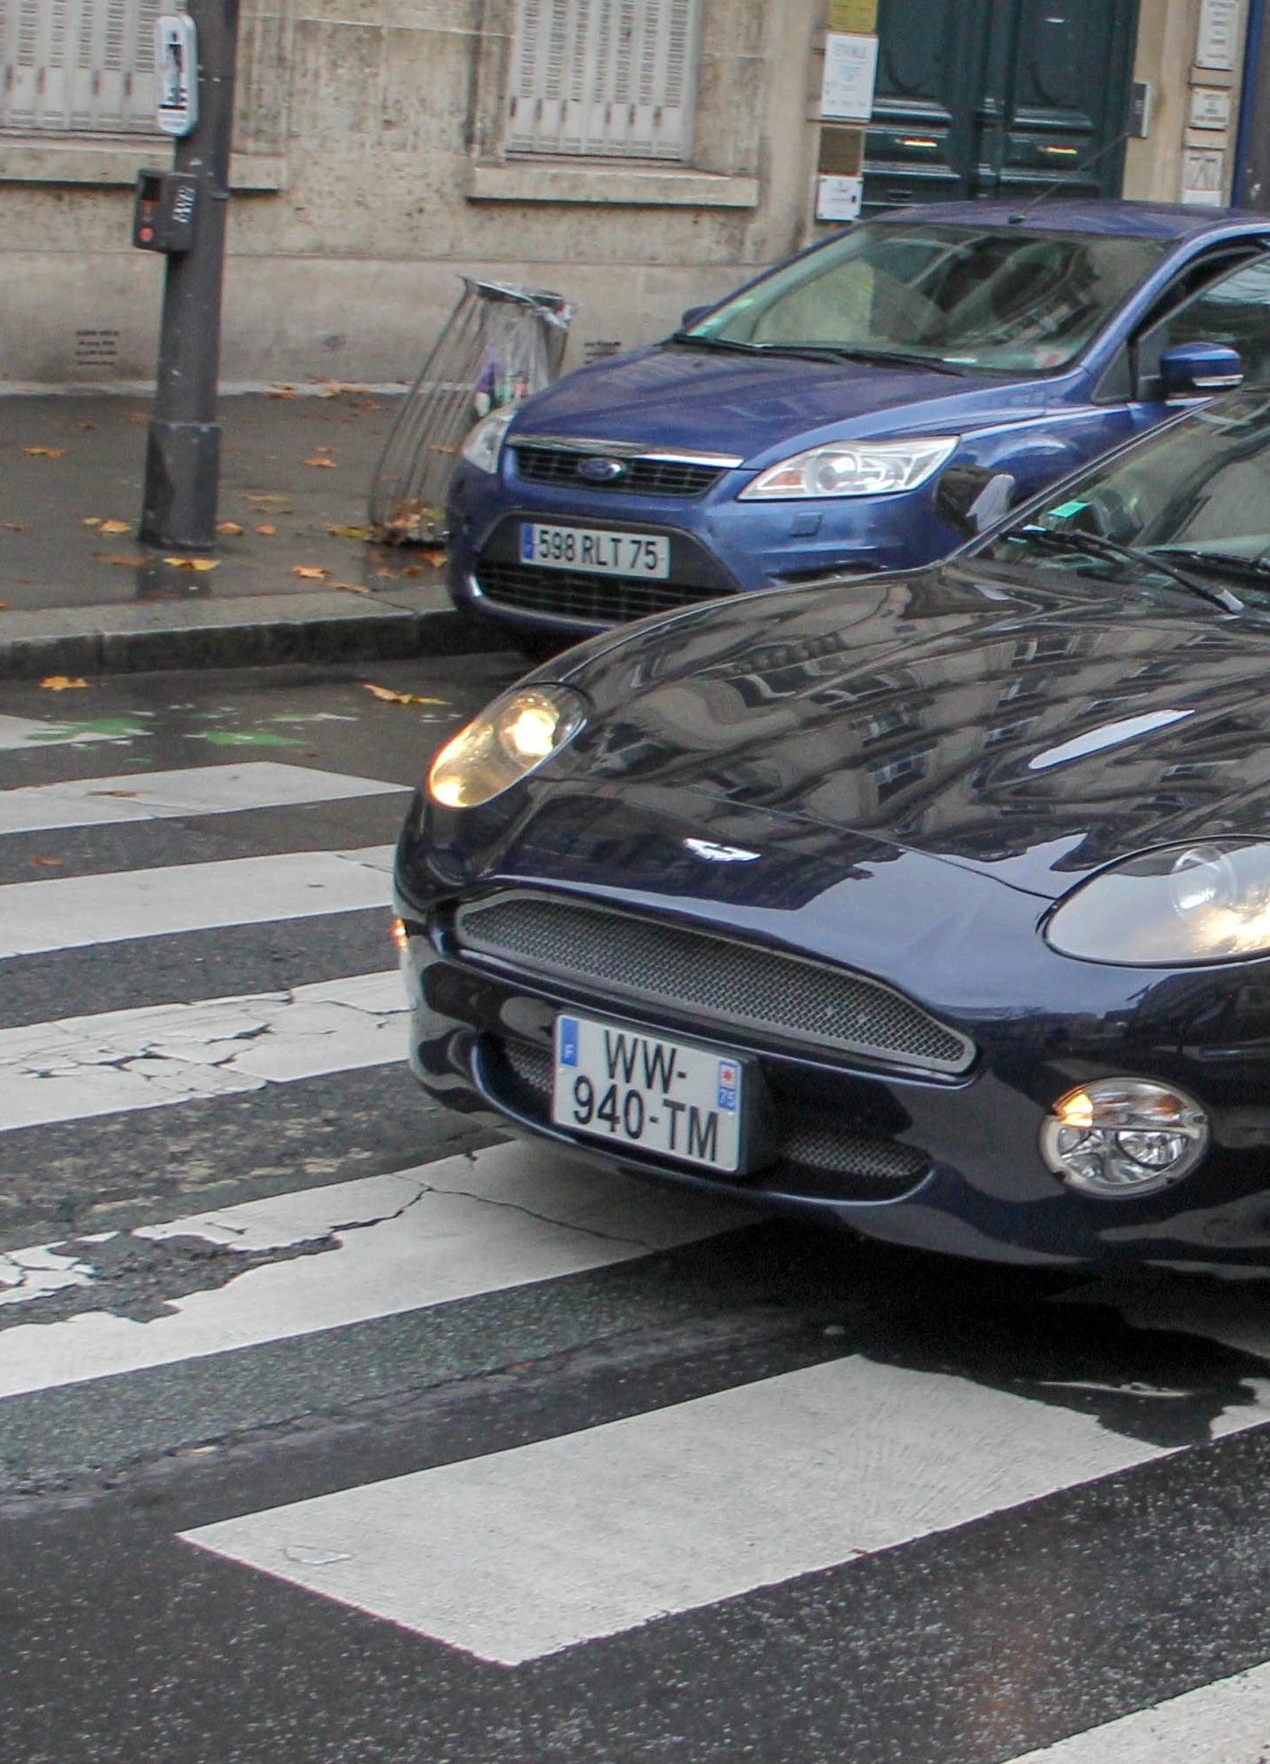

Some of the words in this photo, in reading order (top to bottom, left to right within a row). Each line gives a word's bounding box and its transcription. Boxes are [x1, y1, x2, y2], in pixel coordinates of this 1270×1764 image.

[539, 529, 576, 563] 598
[582, 534, 623, 567] RLT
[630, 539, 658, 571] 75
[573, 1074, 720, 1163] 940-TM
[719, 1089, 736, 1108] 75
